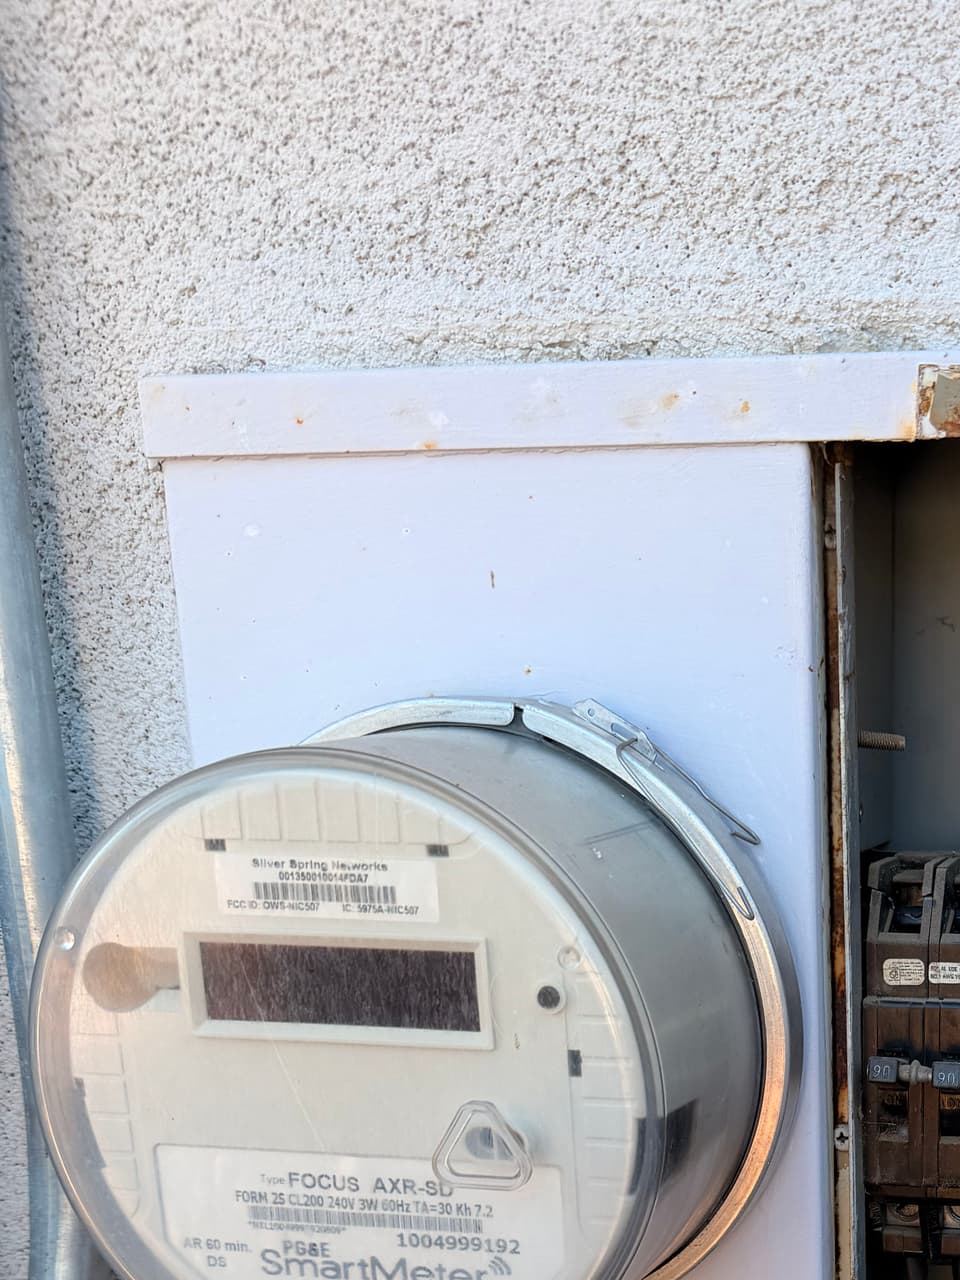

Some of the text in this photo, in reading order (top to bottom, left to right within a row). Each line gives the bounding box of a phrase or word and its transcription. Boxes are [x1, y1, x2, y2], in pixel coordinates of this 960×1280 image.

[252, 858, 285, 869] Silver
[290, 859, 328, 871] Spring
[227, 900, 246, 909] FCC
[260, 1172, 455, 1197] Type FOCUS AXR-SD
[235, 1190, 494, 1218] FORM 2S CL200 240V 3W 60Hz TA=30 Kh 7.2
[183, 1237, 252, 1253] AR 60 min.
[282, 1239, 331, 1258] PG&E
[397, 1233, 521, 1255] 1004999192
[206, 1255, 227, 1268] DS
